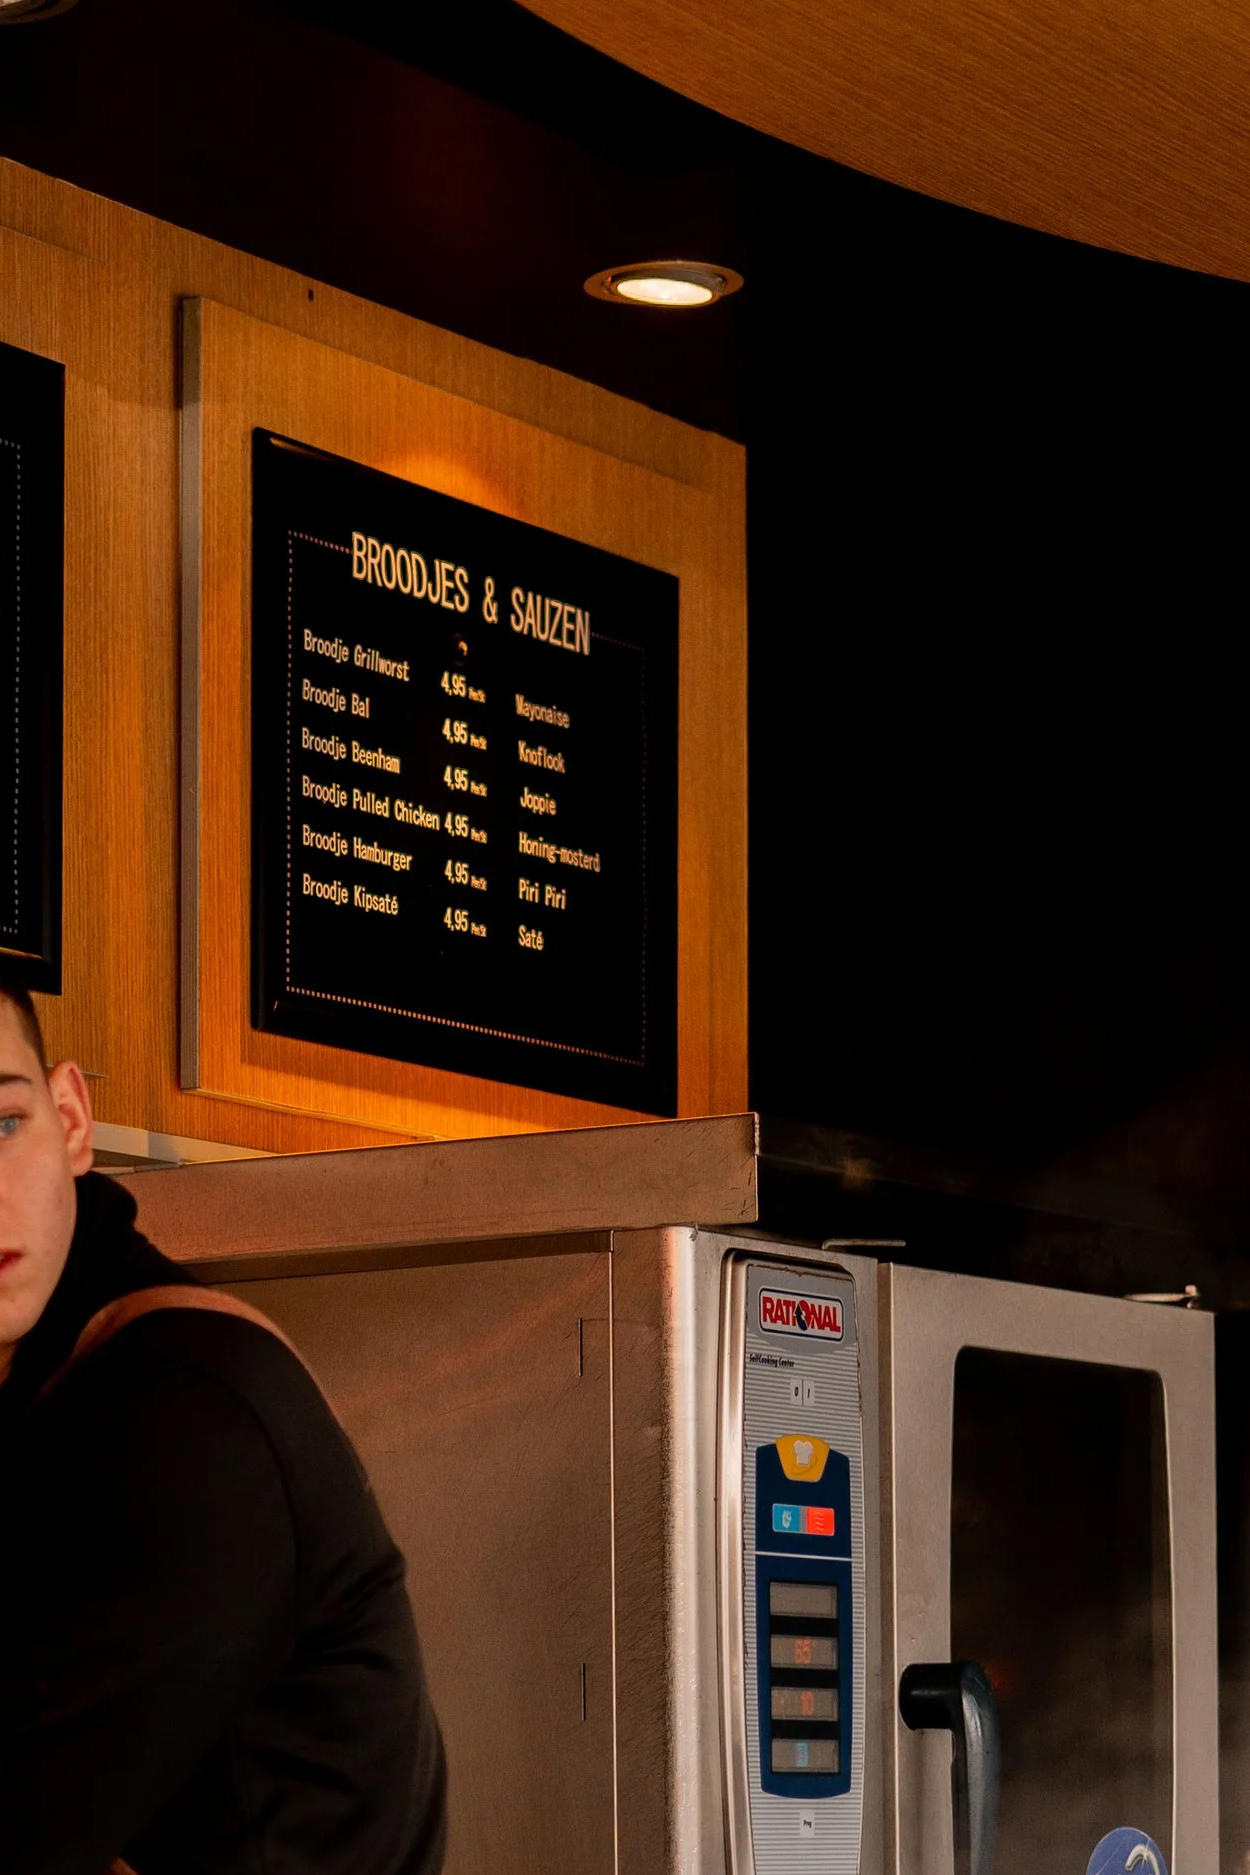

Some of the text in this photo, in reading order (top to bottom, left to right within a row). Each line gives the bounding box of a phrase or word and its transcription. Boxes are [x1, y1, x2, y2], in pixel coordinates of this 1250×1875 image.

[352, 532, 590, 655] BROODJES & SAUZEN
[304, 629, 349, 663] Broodje
[354, 645, 410, 681] Grillworst
[302, 679, 347, 712] Broodje
[352, 693, 370, 719] Bal
[516, 694, 570, 729] Mayonaise
[302, 727, 347, 760] Broodje
[352, 741, 401, 774] Beenham
[518, 740, 566, 773] Knoflook
[302, 775, 347, 806] Broodje
[353, 788, 390, 818] Pulled
[394, 799, 440, 830] Chicken
[520, 787, 557, 815] Joppie
[303, 824, 348, 857] Broodje
[354, 837, 413, 872] Hamburger
[519, 832, 601, 873] Honing-mosterd
[303, 873, 348, 905] Broodje
[354, 885, 398, 916] Kipsaté
[519, 878, 566, 910] Piri Piri
[518, 925, 544, 951] Saté
[762, 1296, 841, 1333] RATIONAL
